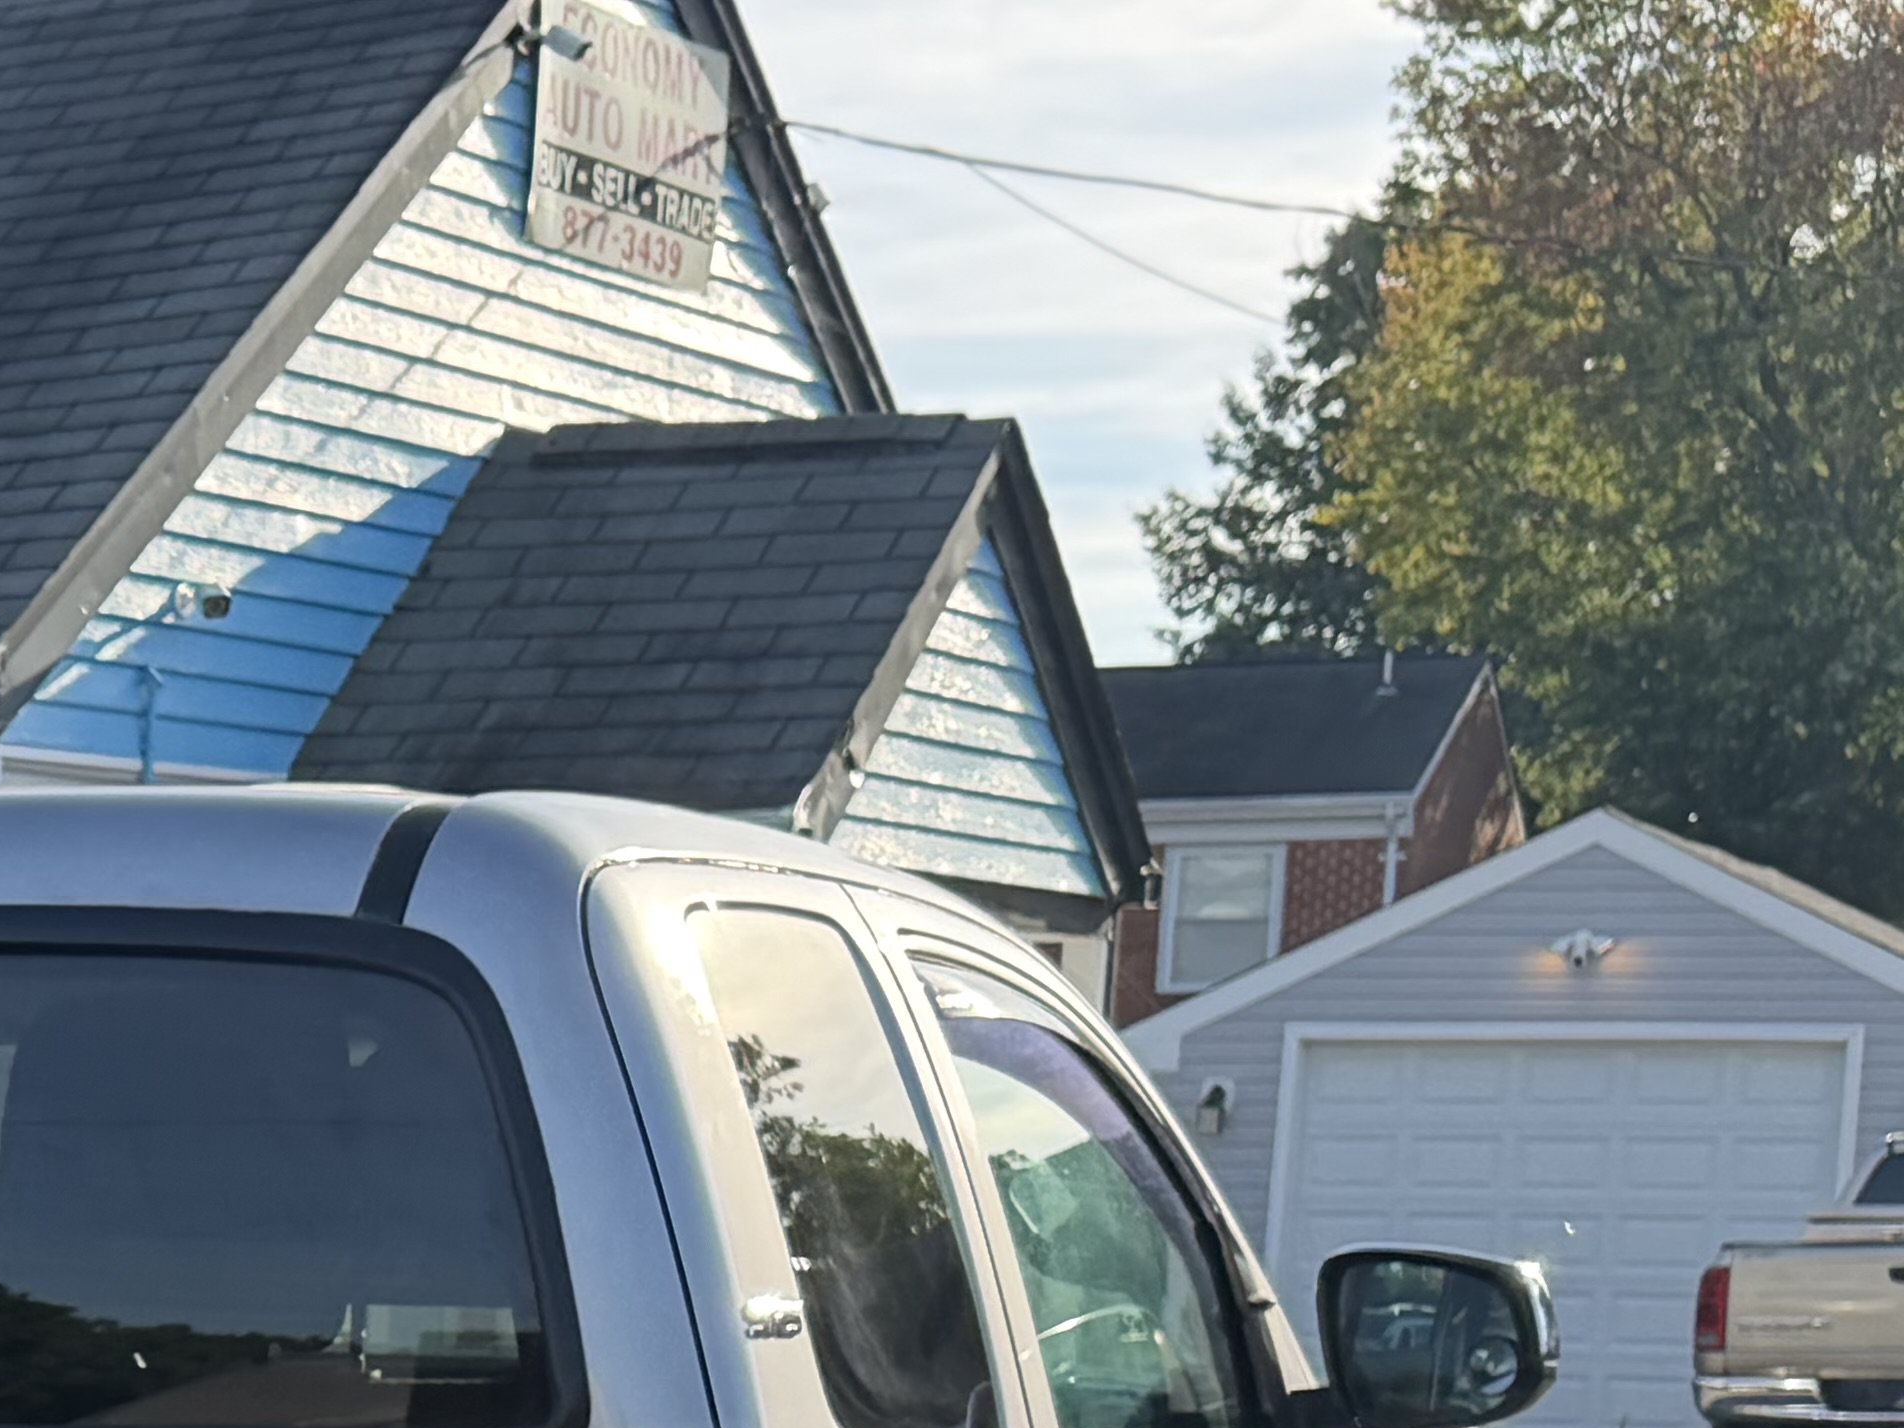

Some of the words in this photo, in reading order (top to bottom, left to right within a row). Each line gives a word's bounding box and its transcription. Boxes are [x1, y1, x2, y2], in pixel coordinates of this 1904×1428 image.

[543, 72, 624, 151] AUTO
[537, 143, 578, 194] BUY
[591, 162, 640, 214] SELL
[655, 182, 716, 238] TRADE
[562, 205, 683, 278] 877-3439
